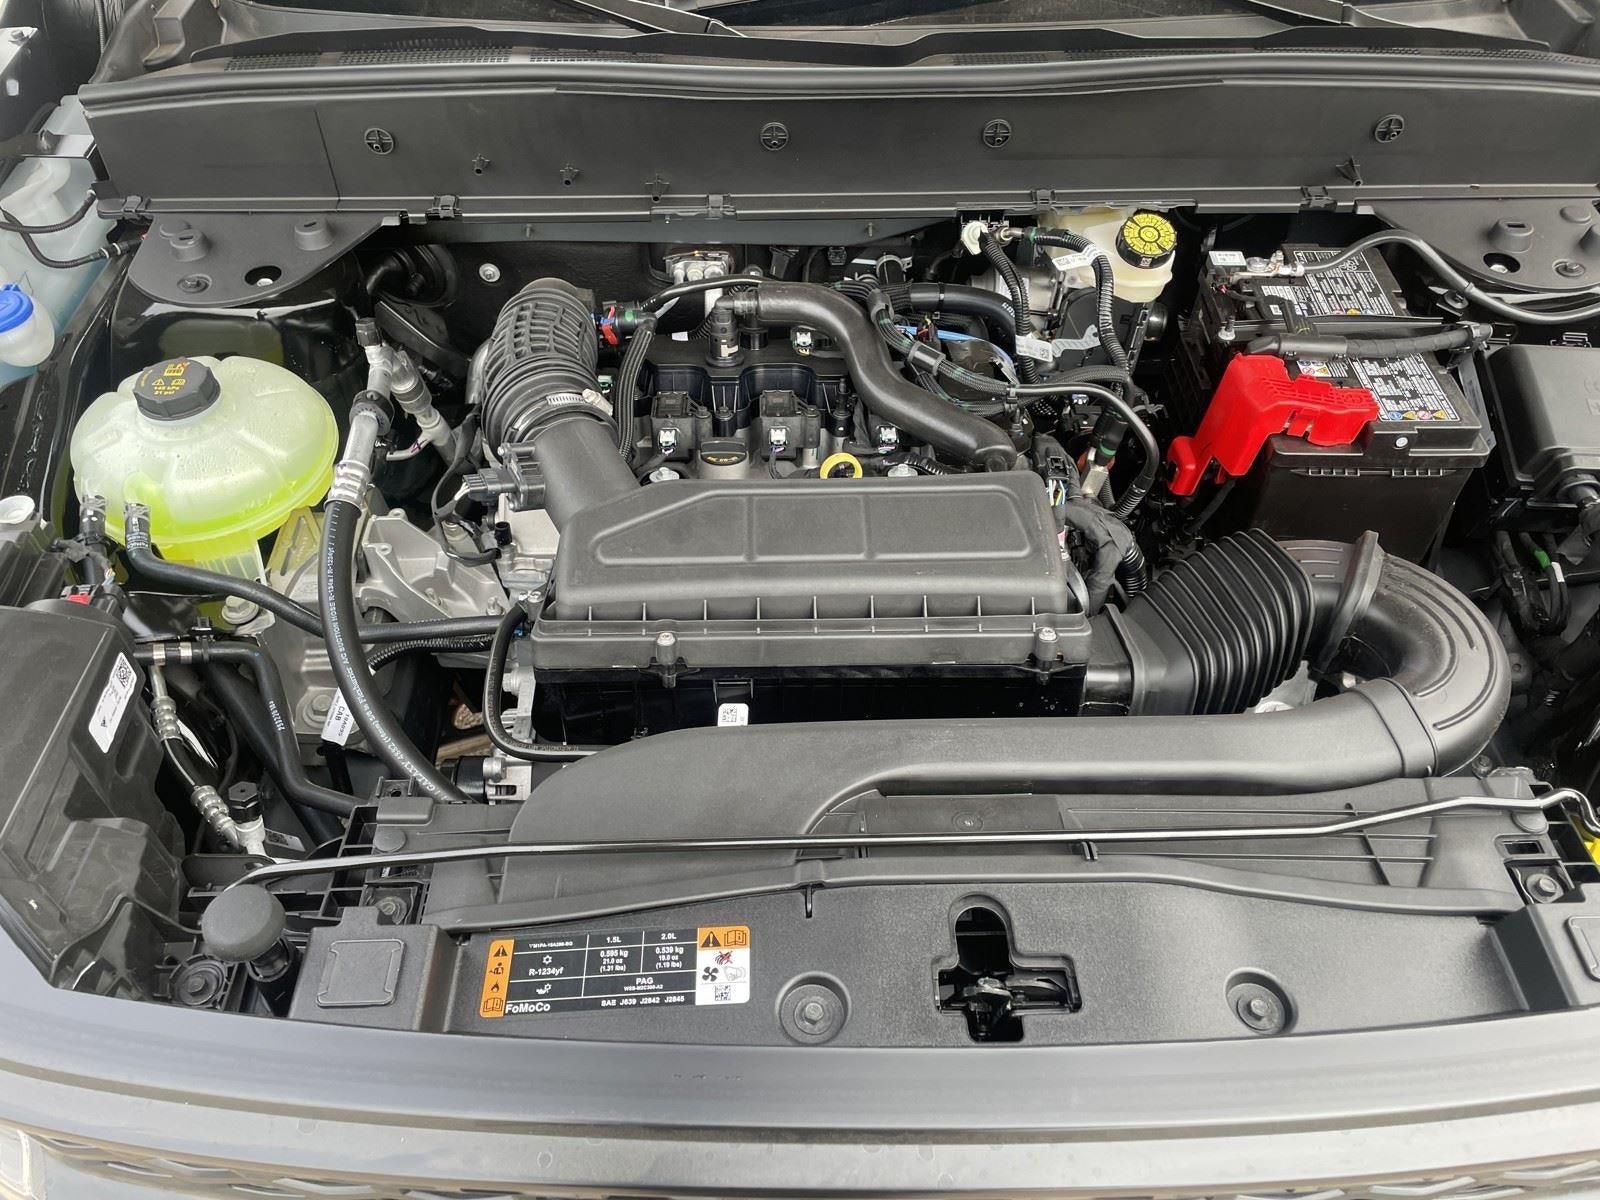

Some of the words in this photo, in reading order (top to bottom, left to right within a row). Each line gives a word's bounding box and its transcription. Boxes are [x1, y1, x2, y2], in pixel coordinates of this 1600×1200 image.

[328, 601, 338, 622] HOSE
[330, 621, 346, 653] SUCTION
[335, 705, 344, 721] CAB
[661, 932, 677, 940] 2.0L
[600, 950, 618, 958] 0.595
[619, 949, 629, 958] kg
[655, 947, 673, 955] 0.539
[674, 946, 684, 954] kg
[528, 967, 564, 976] R-1234yf
[635, 977, 653, 985] PAG
[505, 1002, 551, 1013] FoMoCo
